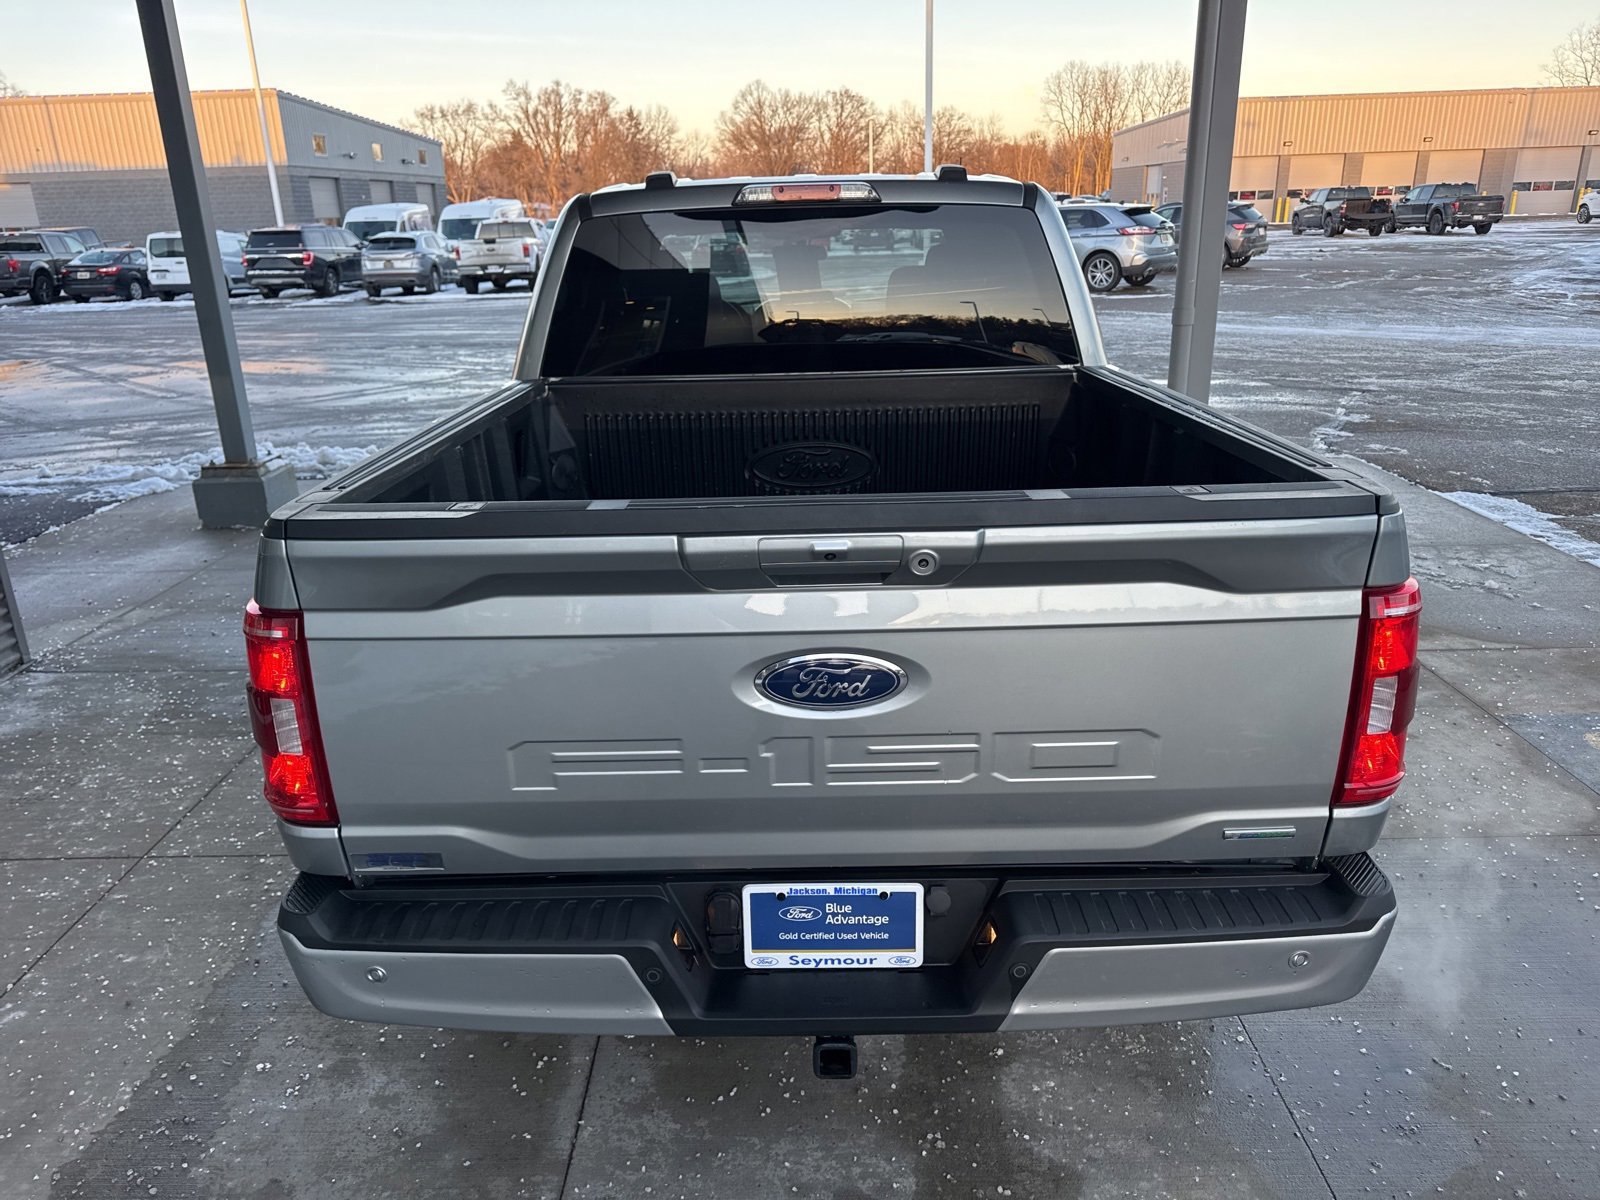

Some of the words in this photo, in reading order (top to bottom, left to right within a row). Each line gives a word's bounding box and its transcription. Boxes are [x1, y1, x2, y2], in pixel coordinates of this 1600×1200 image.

[778, 449, 849, 478] Ford
[791, 667, 871, 698] Ford
[507, 729, 1162, 793] F-150
[834, 887, 878, 896] Michigan
[786, 908, 814, 919] Ford
[825, 903, 852, 913] Blue
[825, 914, 889, 926] Advantage
[778, 932, 798, 940] Gold
[800, 932, 835, 940] Certified
[836, 932, 858, 940] Used
[860, 931, 889, 940] Vehicle
[789, 955, 877, 968] Seymour
